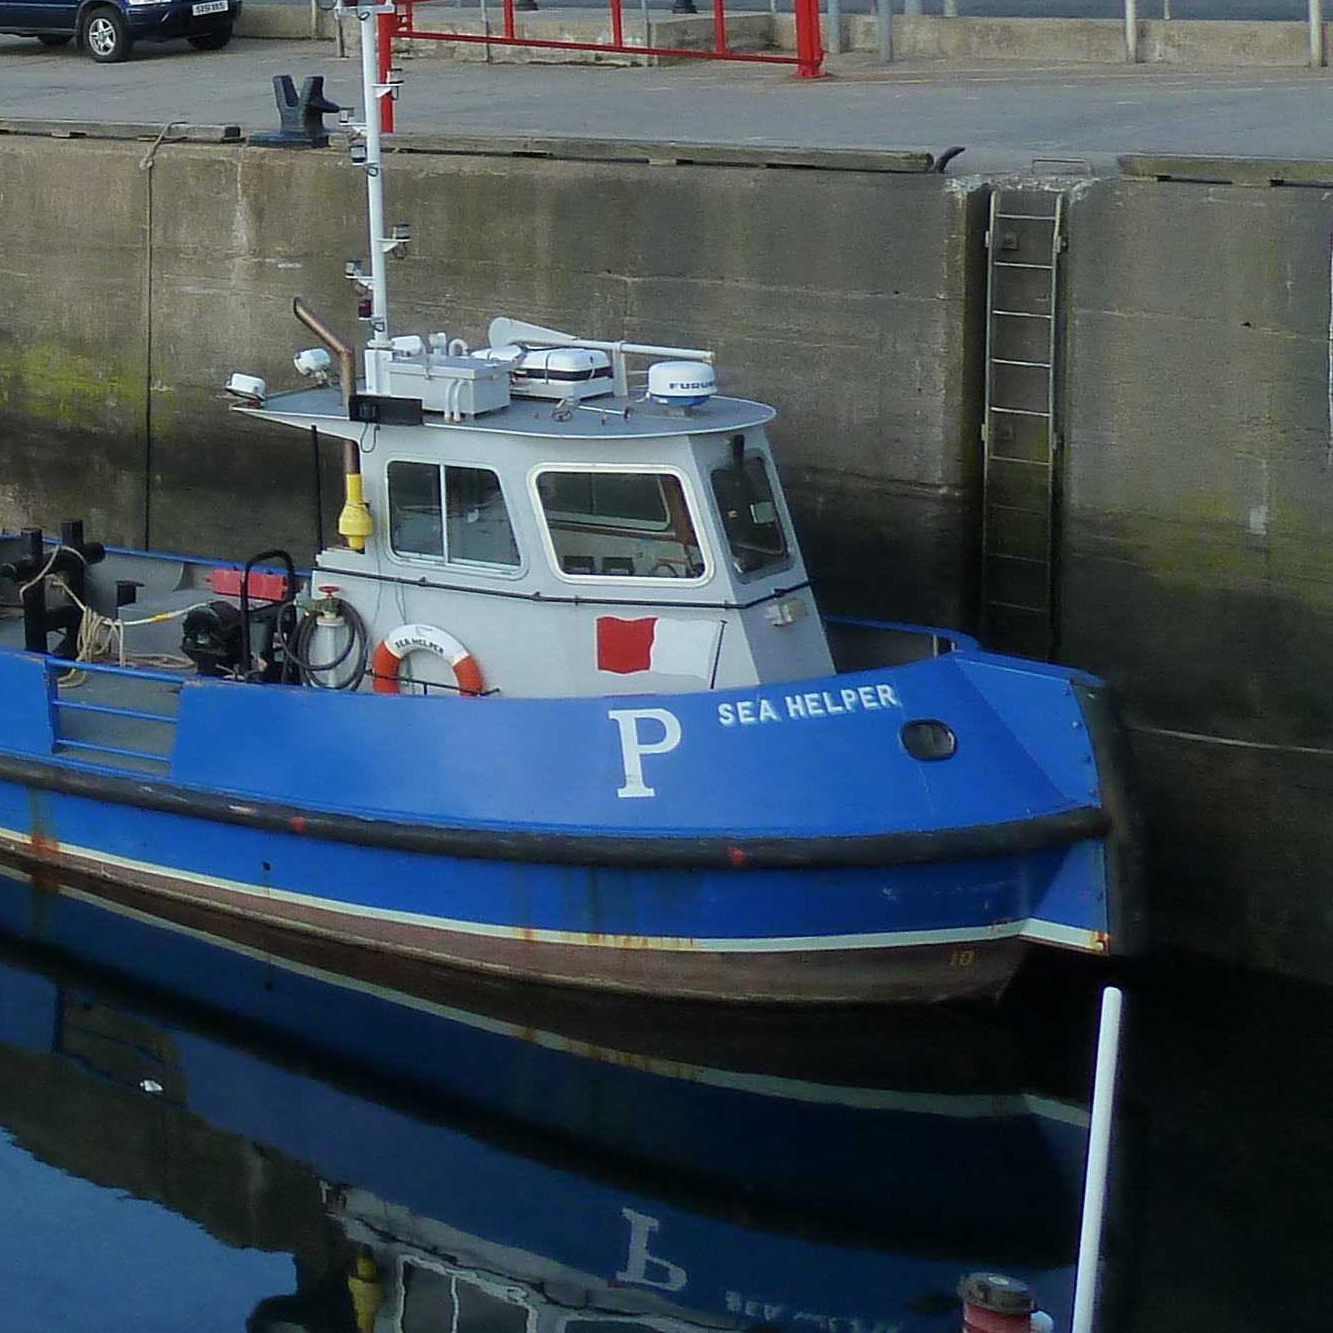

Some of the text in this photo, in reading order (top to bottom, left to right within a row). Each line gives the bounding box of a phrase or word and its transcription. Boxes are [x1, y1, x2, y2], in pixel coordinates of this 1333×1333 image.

[395, 638, 444, 655] SEA HELPER
[718, 684, 902, 726] SEA HELPER
[608, 708, 682, 798] P
